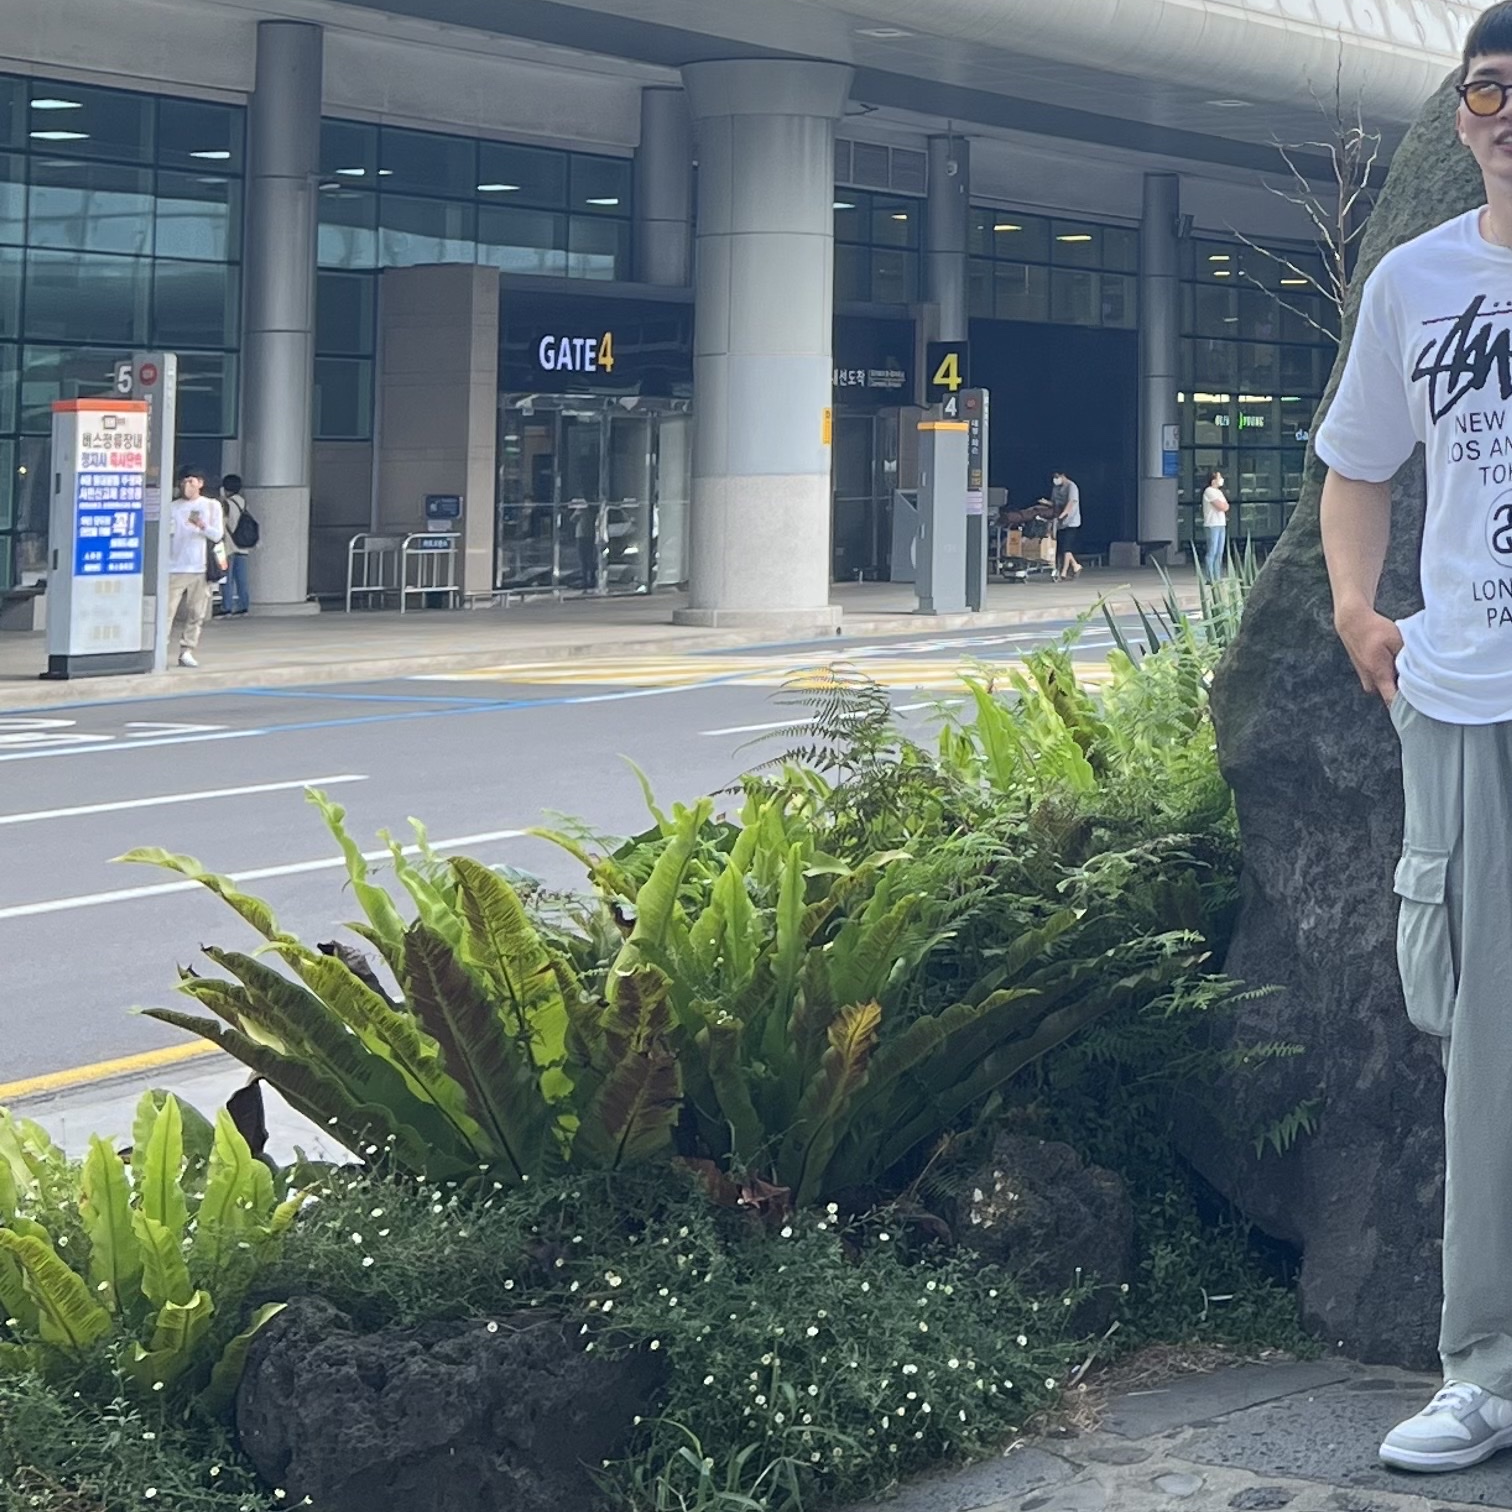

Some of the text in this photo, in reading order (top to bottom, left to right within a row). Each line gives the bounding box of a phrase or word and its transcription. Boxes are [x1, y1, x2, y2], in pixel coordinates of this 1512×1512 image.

[117, 365, 133, 394] 5
[933, 353, 962, 392] 4
[944, 396, 958, 417] 4
[1455, 410, 1506, 435] NEW
